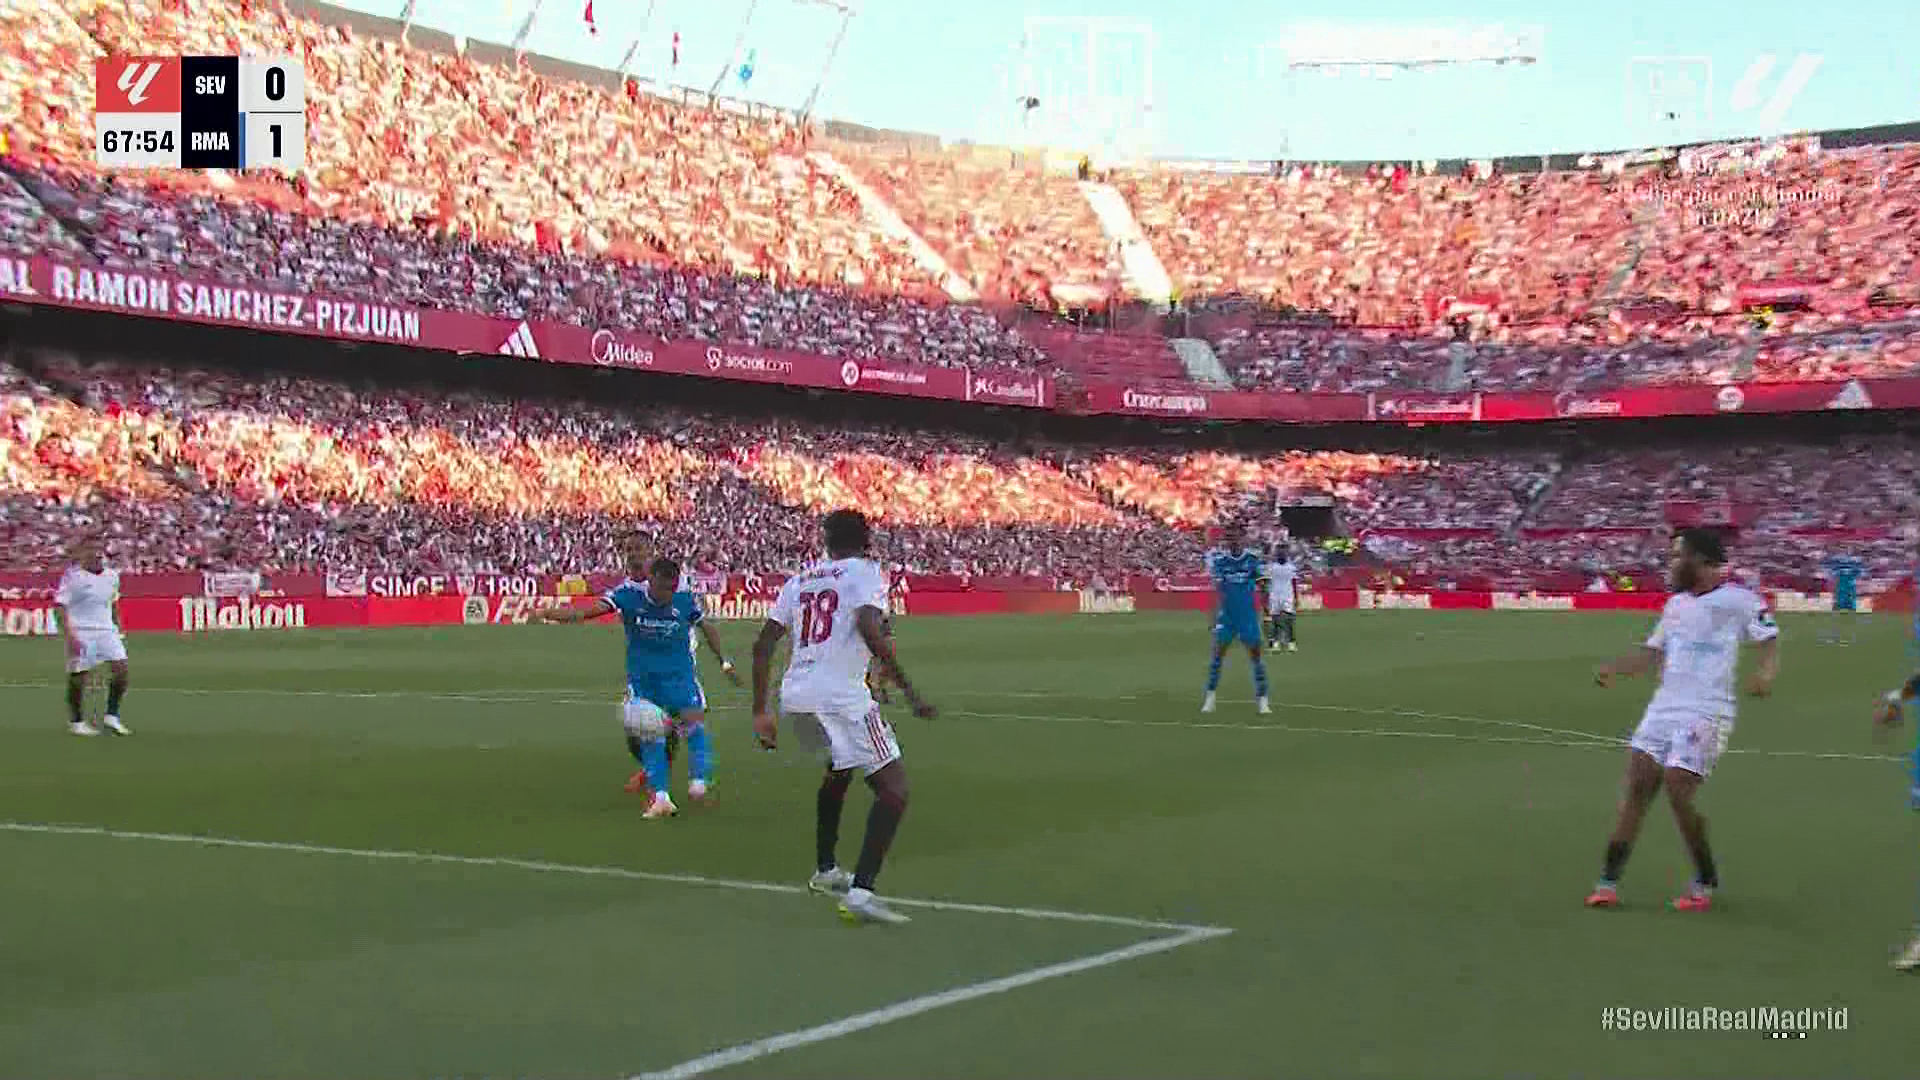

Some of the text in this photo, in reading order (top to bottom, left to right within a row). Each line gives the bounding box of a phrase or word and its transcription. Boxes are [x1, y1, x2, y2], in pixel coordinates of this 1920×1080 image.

[52, 265, 169, 312] RAMON
[177, 283, 420, 340] SANCHEZ-PIZJUAN
[370, 575, 444, 597] SINCE
[485, 574, 537, 597] 1890
[179, 596, 305, 632] Mahou
[798, 588, 839, 648] 18
